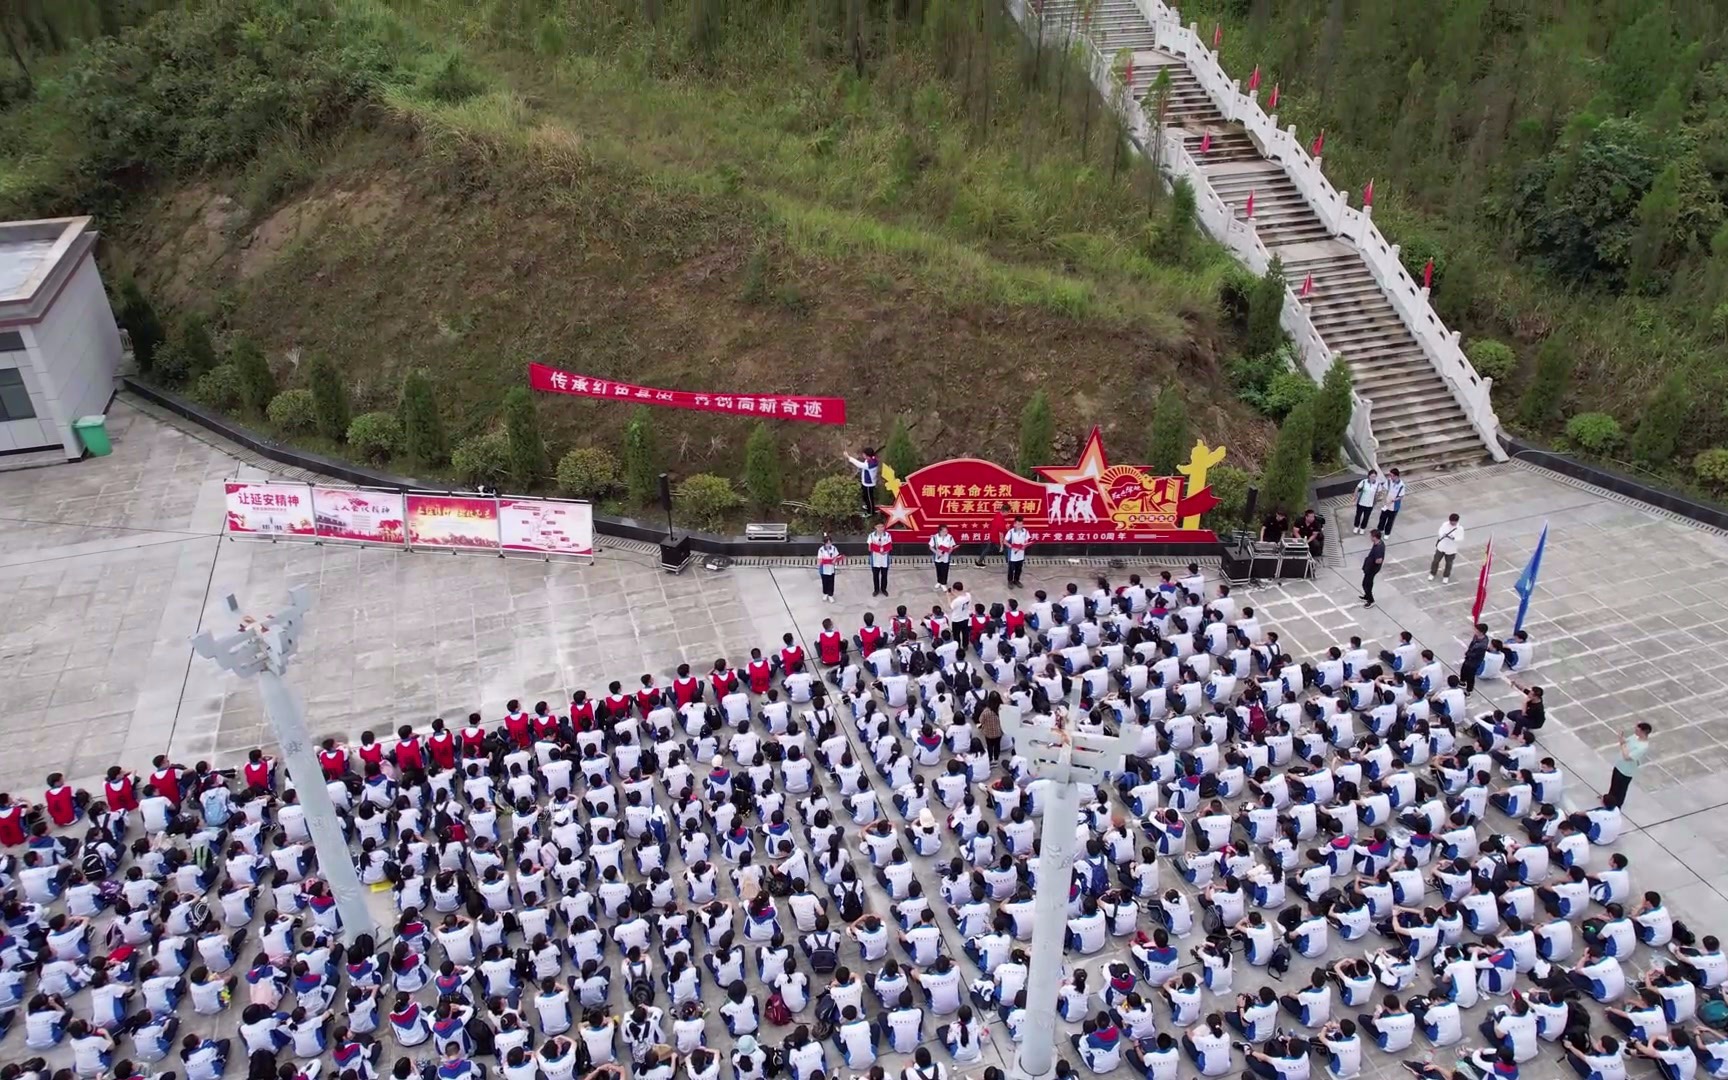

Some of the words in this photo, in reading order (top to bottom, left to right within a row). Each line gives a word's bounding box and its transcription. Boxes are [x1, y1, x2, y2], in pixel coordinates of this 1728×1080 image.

[921, 484, 1013, 498] 缅怀革命先烈
[238, 492, 300, 507] 让延安精神
[945, 500, 1037, 513] 传承红色精神
